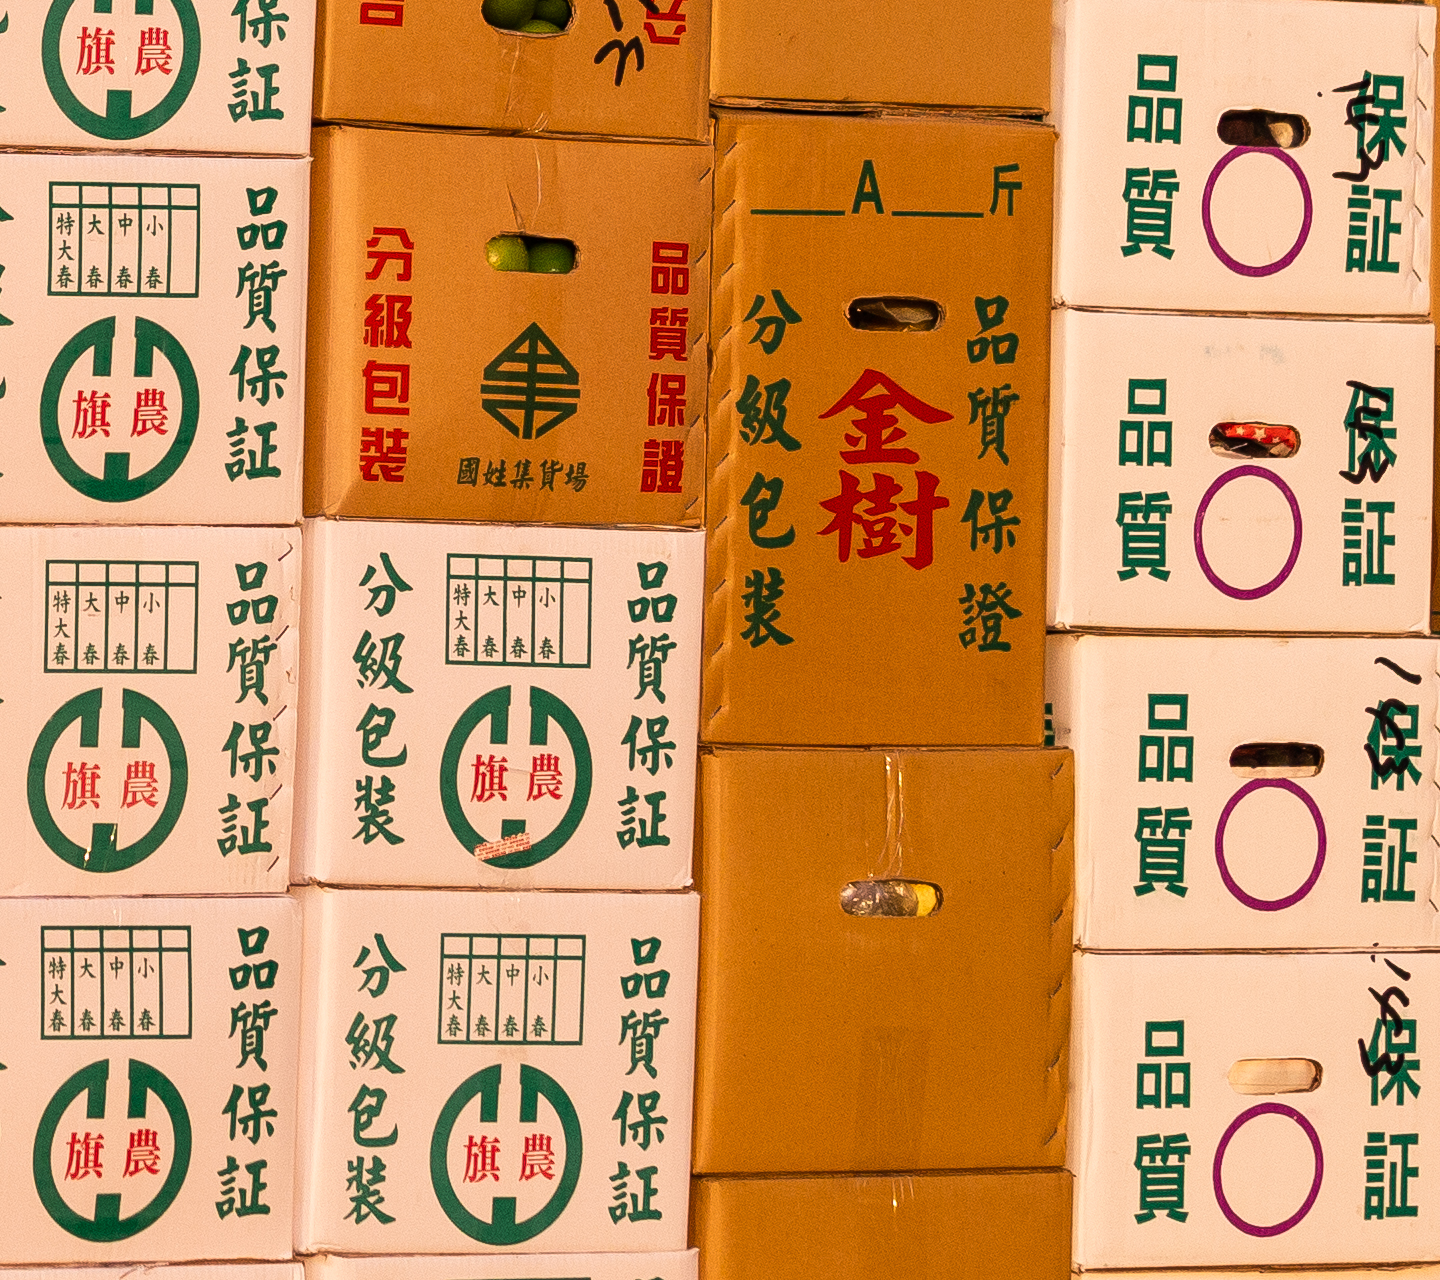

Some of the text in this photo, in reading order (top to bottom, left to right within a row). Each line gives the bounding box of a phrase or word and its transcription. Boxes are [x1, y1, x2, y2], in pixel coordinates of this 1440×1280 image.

[849, 159, 1022, 217] A 斤
[1119, 53, 1182, 260] 品質
[222, 186, 287, 482] 品質保証
[358, 226, 414, 483] 分級包裝
[639, 241, 689, 494] 品質保證
[735, 288, 803, 649] 分級包裝
[816, 368, 953, 571] 金樹
[455, 456, 589, 493] 國姓集貨場
[957, 295, 1022, 653] 品質保證
[1114, 378, 1172, 582] 品質
[215, 561, 279, 857] 品質保証
[351, 551, 413, 846] 分級包裝
[615, 560, 677, 850] 品質保証
[1132, 693, 1193, 898] 品質
[214, 925, 278, 1220] 品質保証
[343, 932, 406, 1225] 分級包裝
[607, 935, 671, 1225] 品質保証
[1132, 1019, 1190, 1225] 品質
